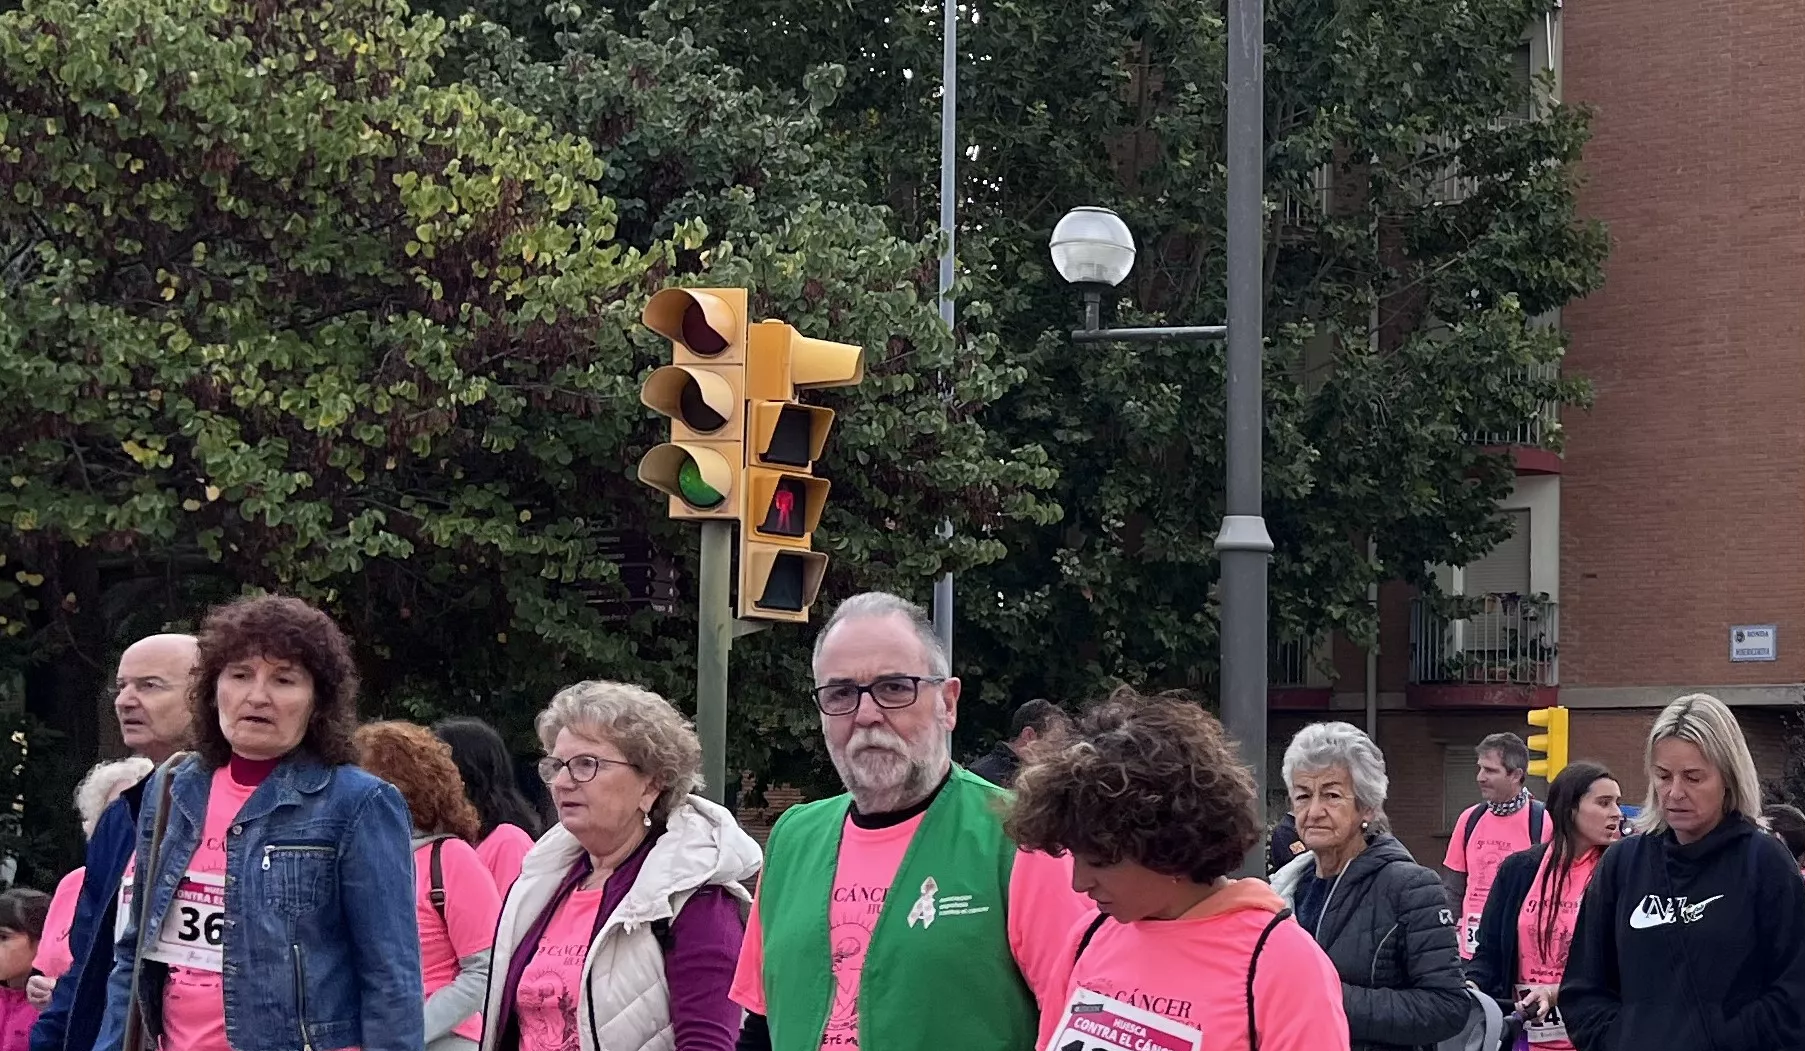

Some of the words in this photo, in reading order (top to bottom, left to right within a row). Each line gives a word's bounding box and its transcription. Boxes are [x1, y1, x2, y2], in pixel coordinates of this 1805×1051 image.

[1073, 1016, 1117, 1042] CONTRA
[1118, 1032, 1132, 1048] EL
[1112, 1018, 1147, 1037] HUESCA
